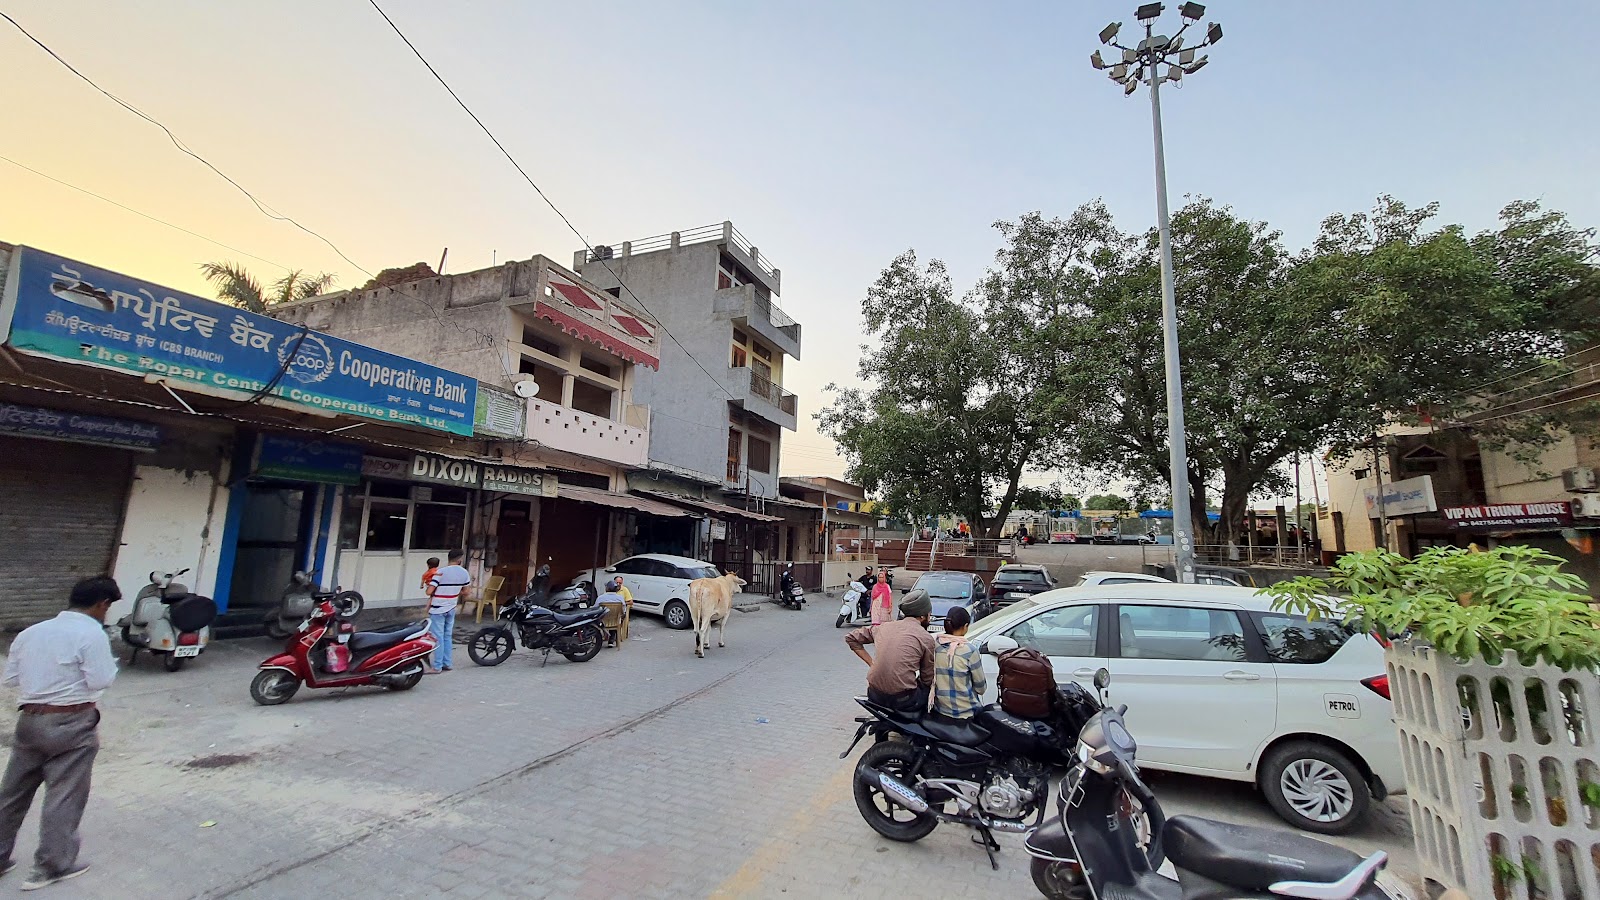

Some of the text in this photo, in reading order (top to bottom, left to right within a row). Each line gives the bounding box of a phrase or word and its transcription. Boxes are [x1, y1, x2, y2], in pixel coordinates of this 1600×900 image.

[230, 315, 274, 352] ਬੈਂਕ
[159, 340, 182, 354] (CBS
[184, 346, 224, 364] BRANCH)
[79, 342, 128, 364] The
[138, 355, 206, 380] Ropar
[290, 389, 385, 417] Cooperative
[389, 409, 421, 424] Bank
[425, 416, 448, 429] Ltd.
[339, 350, 468, 404] Cooperative Bank
[68, 415, 130, 435] Cooperative
[131, 423, 160, 439] Bank
[413, 454, 542, 486] DIXON RADIOS
[490, 482, 518, 492] ELECTRIC
[1444, 502, 1567, 520] VIPAN TRUNK HOUSE
[1328, 701, 1356, 711] PETROL
